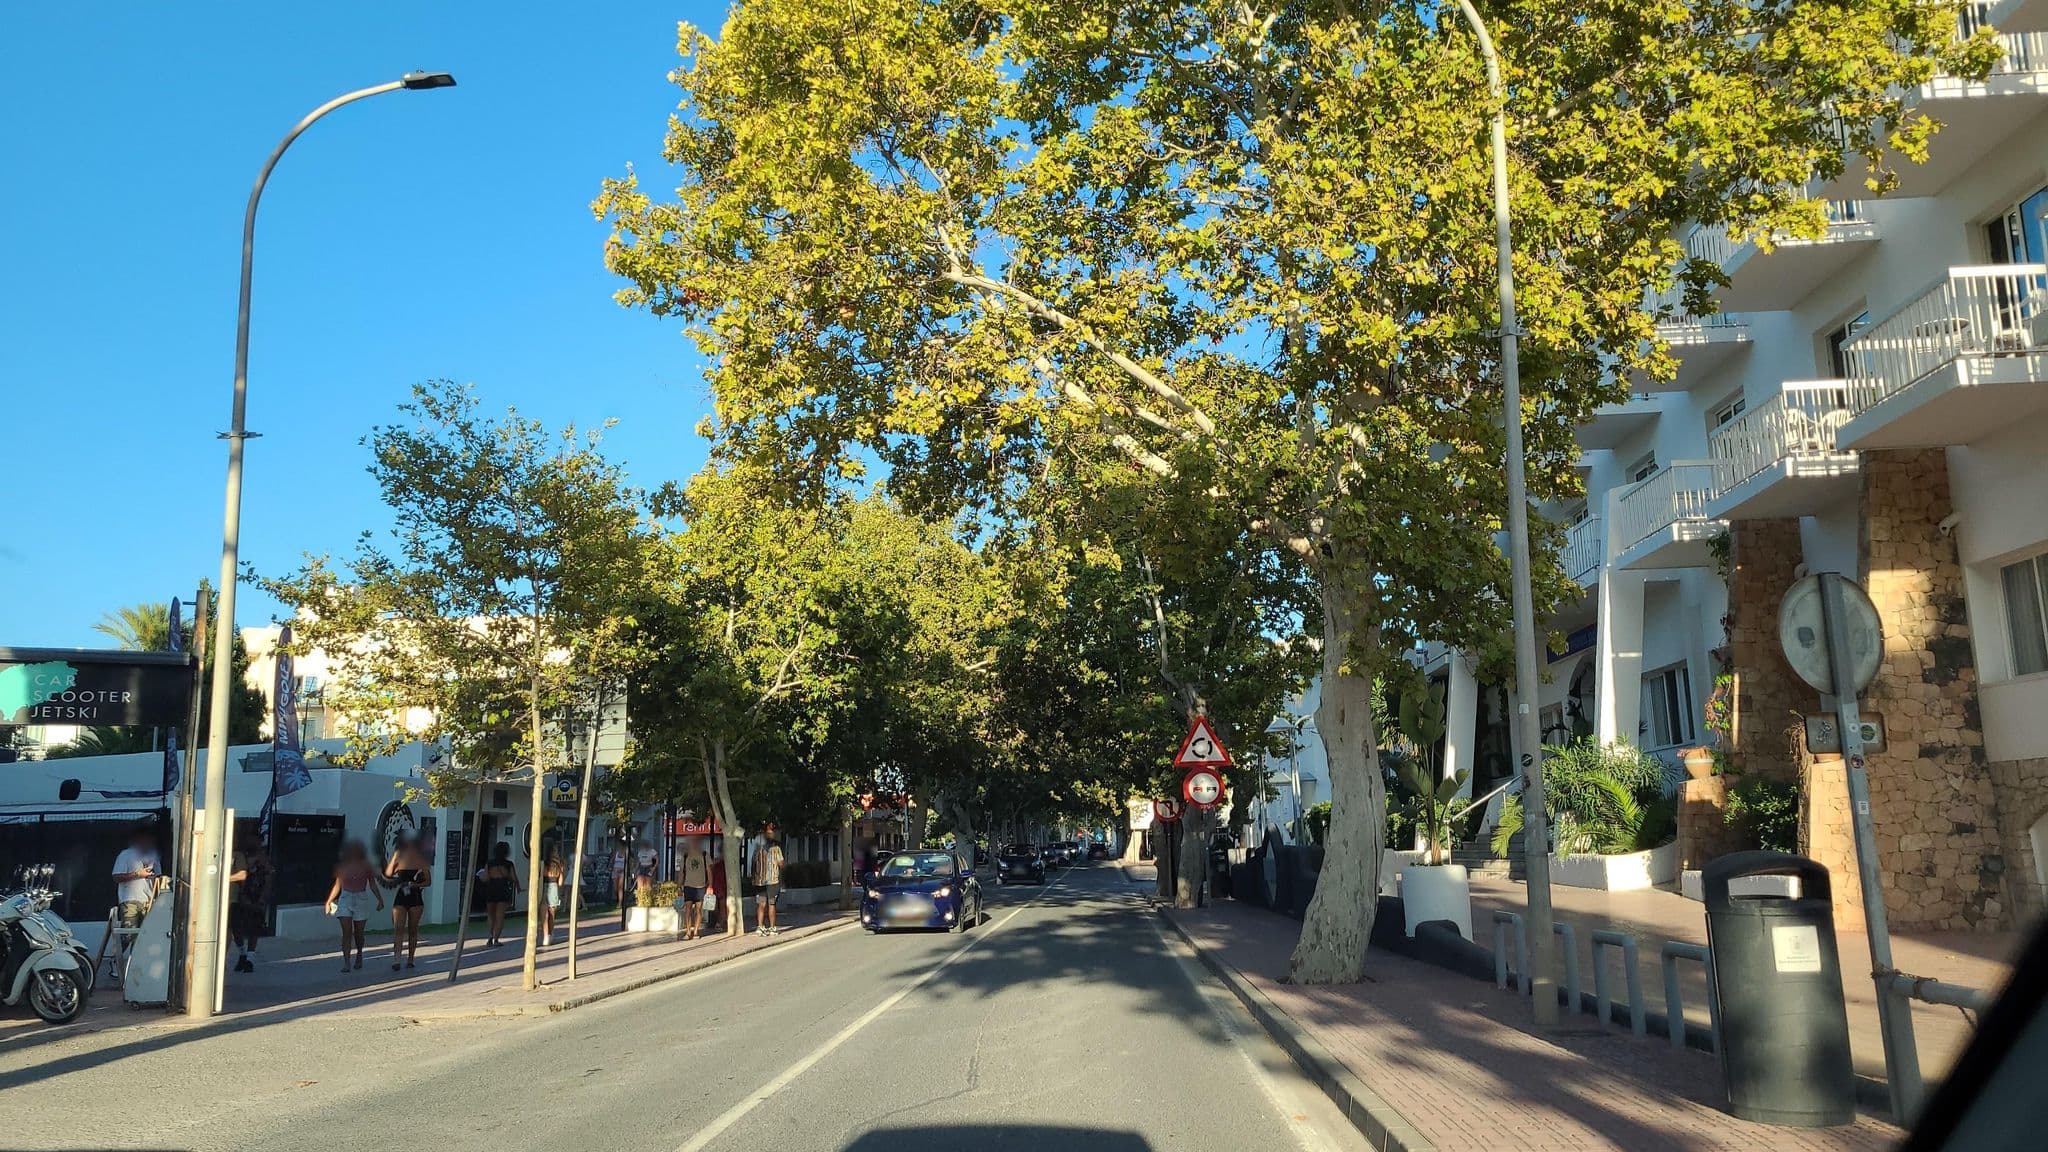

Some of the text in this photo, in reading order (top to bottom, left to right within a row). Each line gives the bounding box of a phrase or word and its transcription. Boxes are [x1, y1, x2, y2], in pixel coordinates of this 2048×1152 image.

[34, 674, 77, 687] CAR
[33, 690, 132, 703] SCOOTER
[31, 706, 98, 719] JETSKI
[556, 793, 574, 801] ATM
